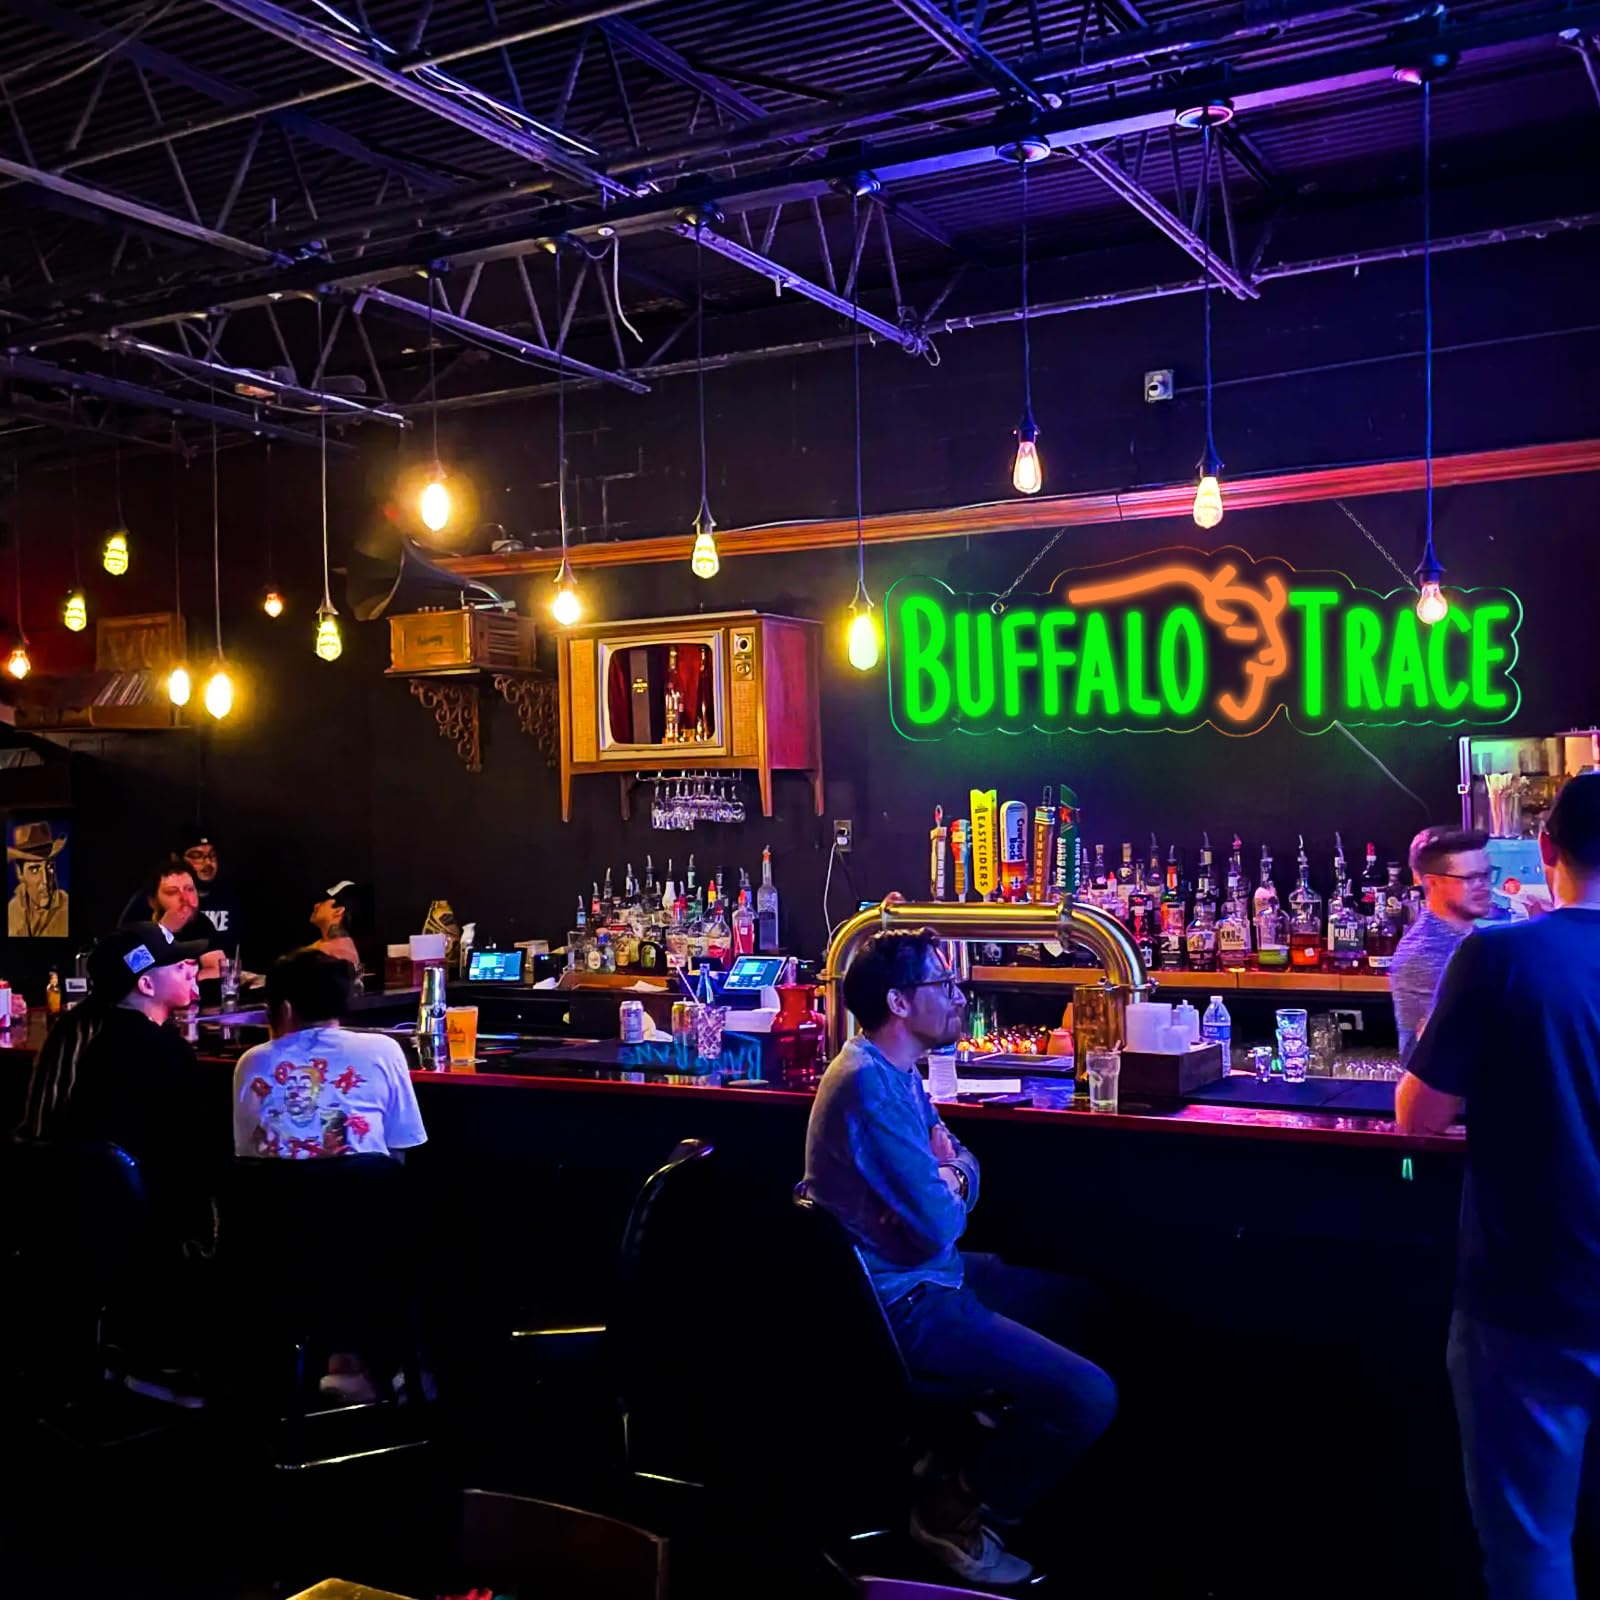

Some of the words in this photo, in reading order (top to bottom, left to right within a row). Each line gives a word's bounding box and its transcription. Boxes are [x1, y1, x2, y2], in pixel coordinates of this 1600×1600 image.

[901, 595, 1204, 725] BUFFALO
[1289, 590, 1510, 717] TRACE
[977, 815, 989, 887] EASTCIDERS
[1009, 837, 1017, 860] Bock
[1016, 818, 1025, 860] Crawford
